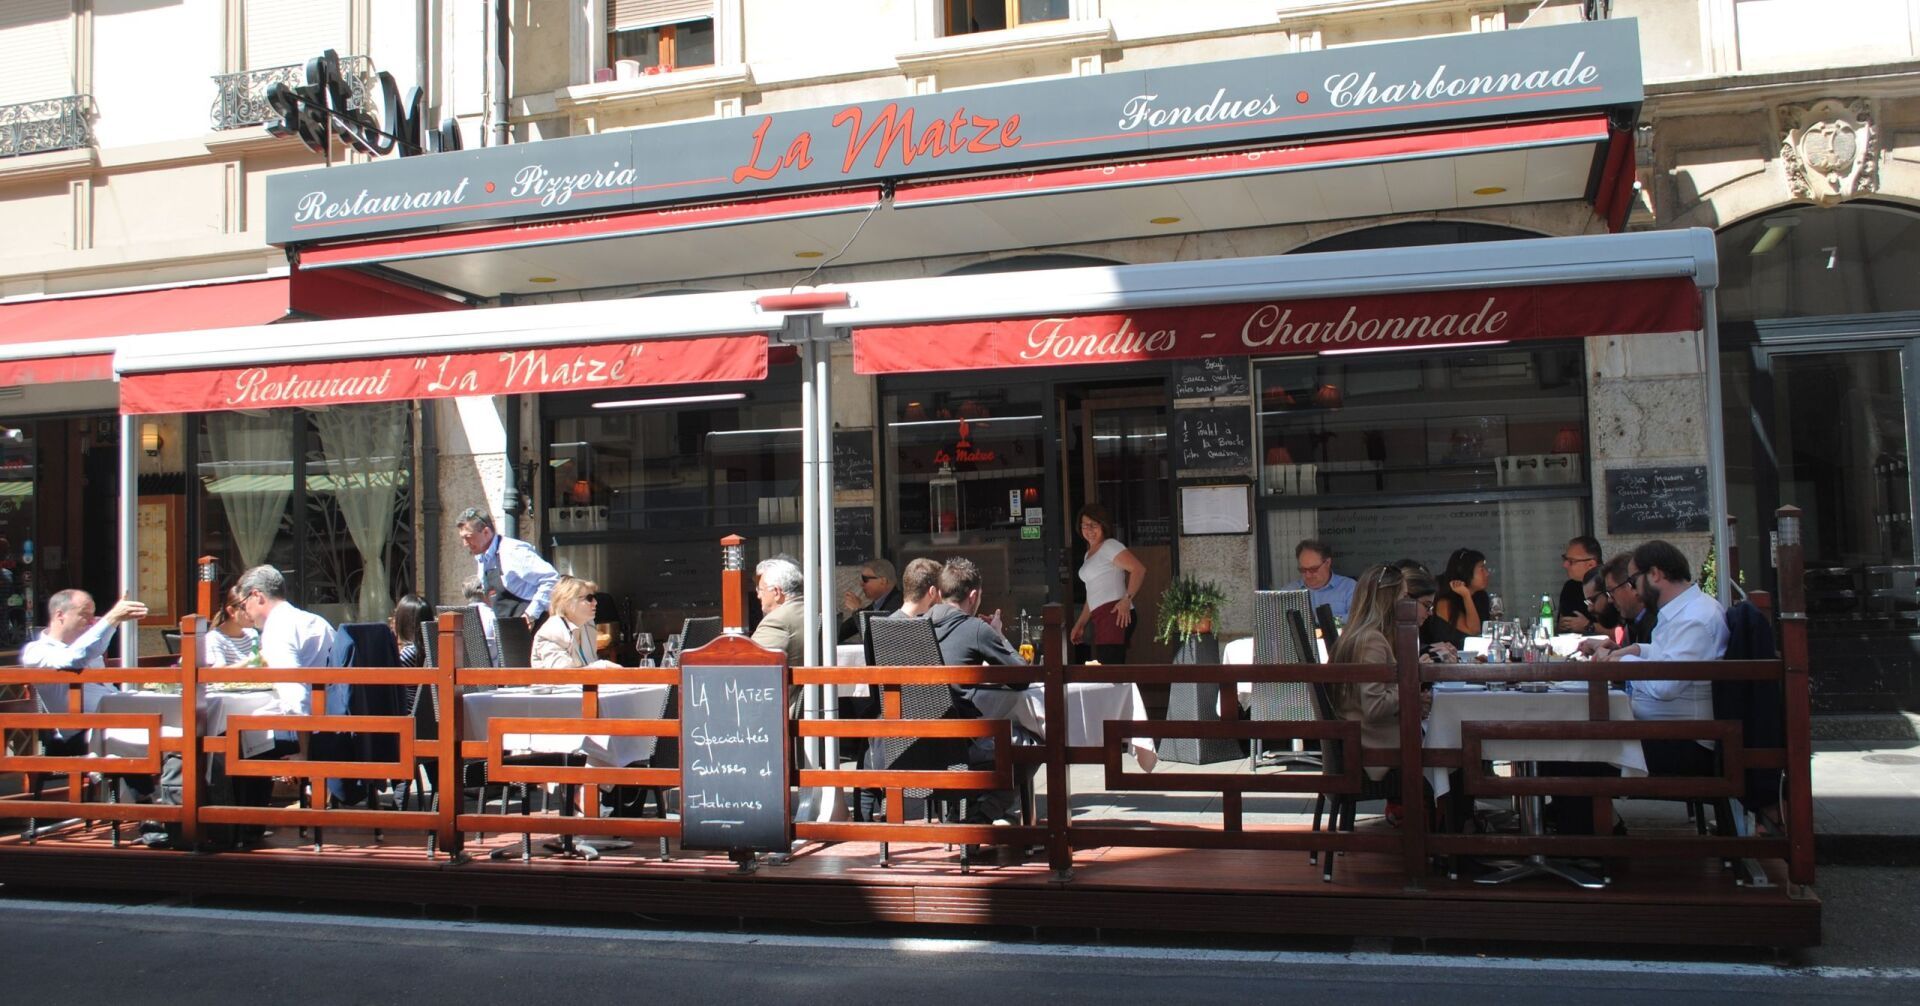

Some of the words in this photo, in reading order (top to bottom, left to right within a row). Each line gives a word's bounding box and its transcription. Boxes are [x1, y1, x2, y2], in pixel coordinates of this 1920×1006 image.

[1118, 88, 1280, 131] Fondues
[1323, 51, 1599, 109] Charbonnade
[734, 115, 812, 184] La
[832, 102, 1022, 173] Matze
[295, 176, 469, 223] Restaurant
[511, 161, 638, 207] Pizzeria
[1821, 246, 1838, 270] 7
[1020, 318, 1178, 360] Fondues
[1241, 297, 1508, 349] Charbonnade
[227, 366, 393, 406] Restaurant
[415, 357, 479, 392] "La
[498, 344, 643, 388] Matze"
[934, 449, 951, 465] La
[690, 674, 710, 717] LA
[691, 759, 747, 777] Suisses
[759, 760, 773, 777] et
[688, 789, 763, 810] Italiennes
